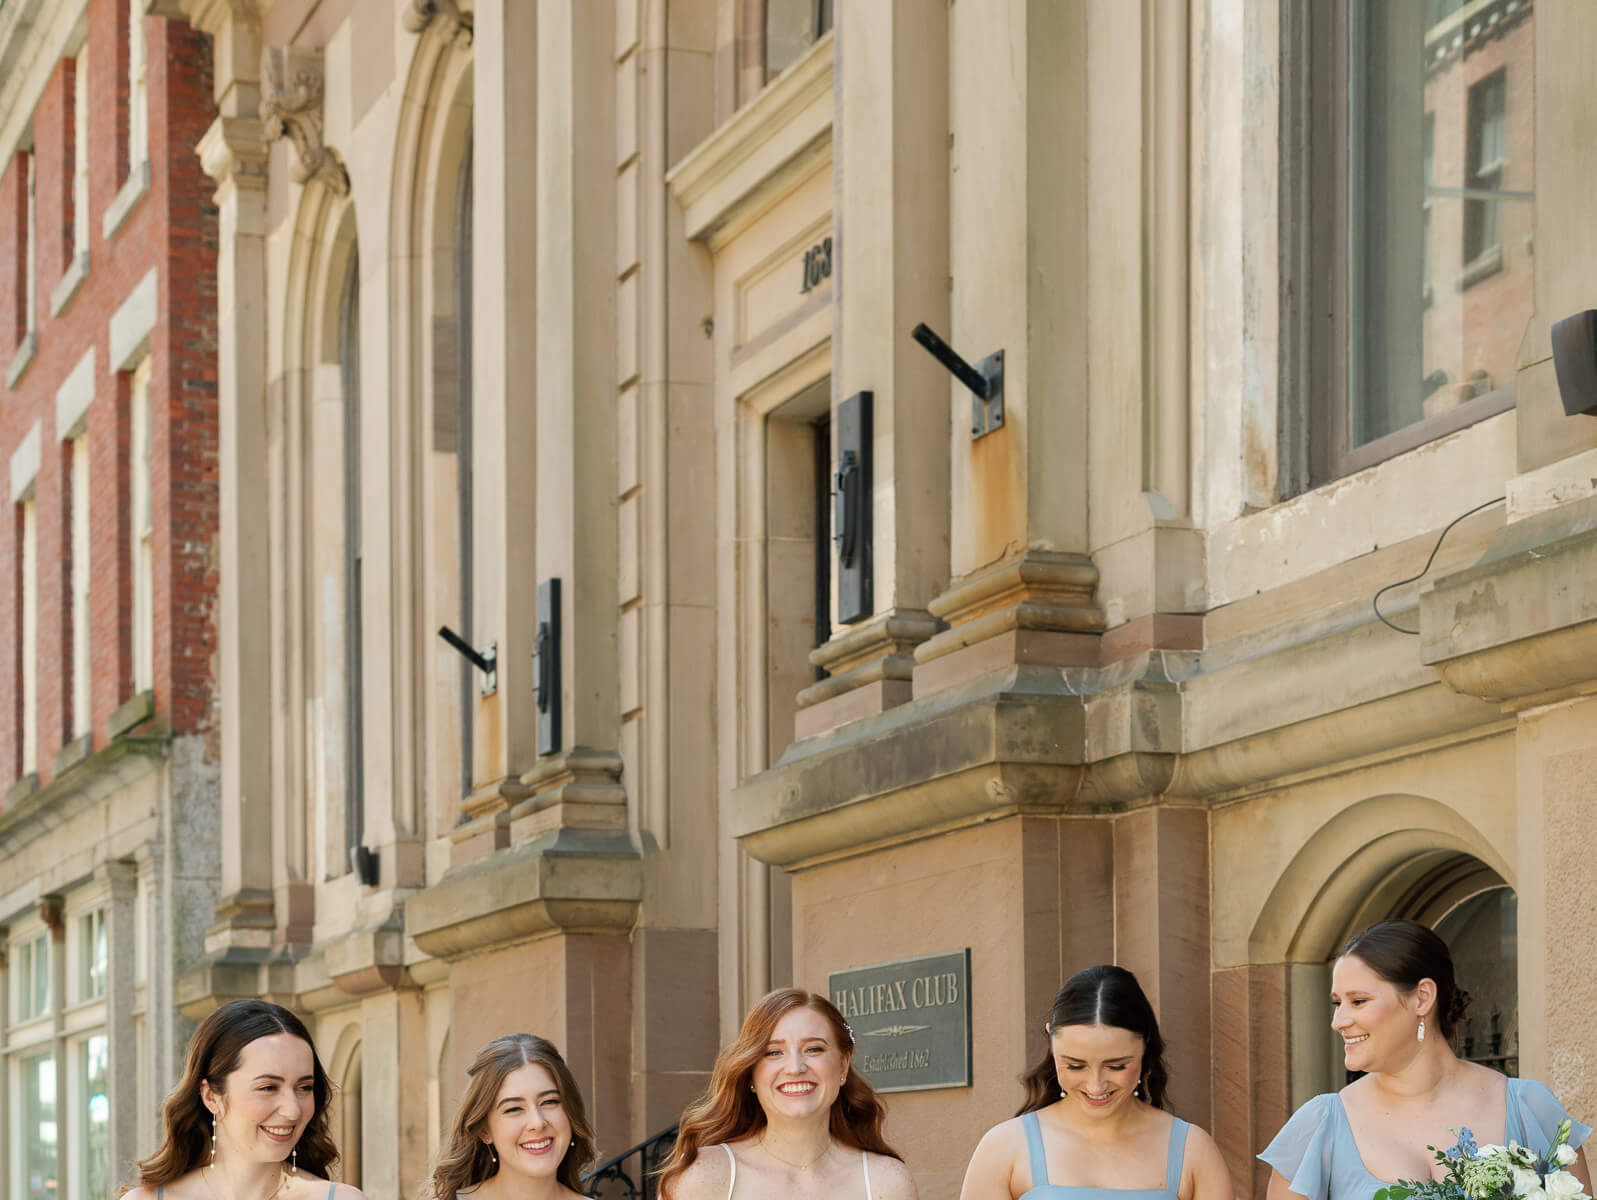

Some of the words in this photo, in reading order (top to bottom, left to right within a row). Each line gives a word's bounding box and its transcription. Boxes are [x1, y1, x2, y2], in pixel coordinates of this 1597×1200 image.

[836, 980, 907, 1018] HALIFAX
[912, 973, 959, 1009] CLUB
[863, 1049, 907, 1073] Established
[909, 1048, 930, 1070] 1862
